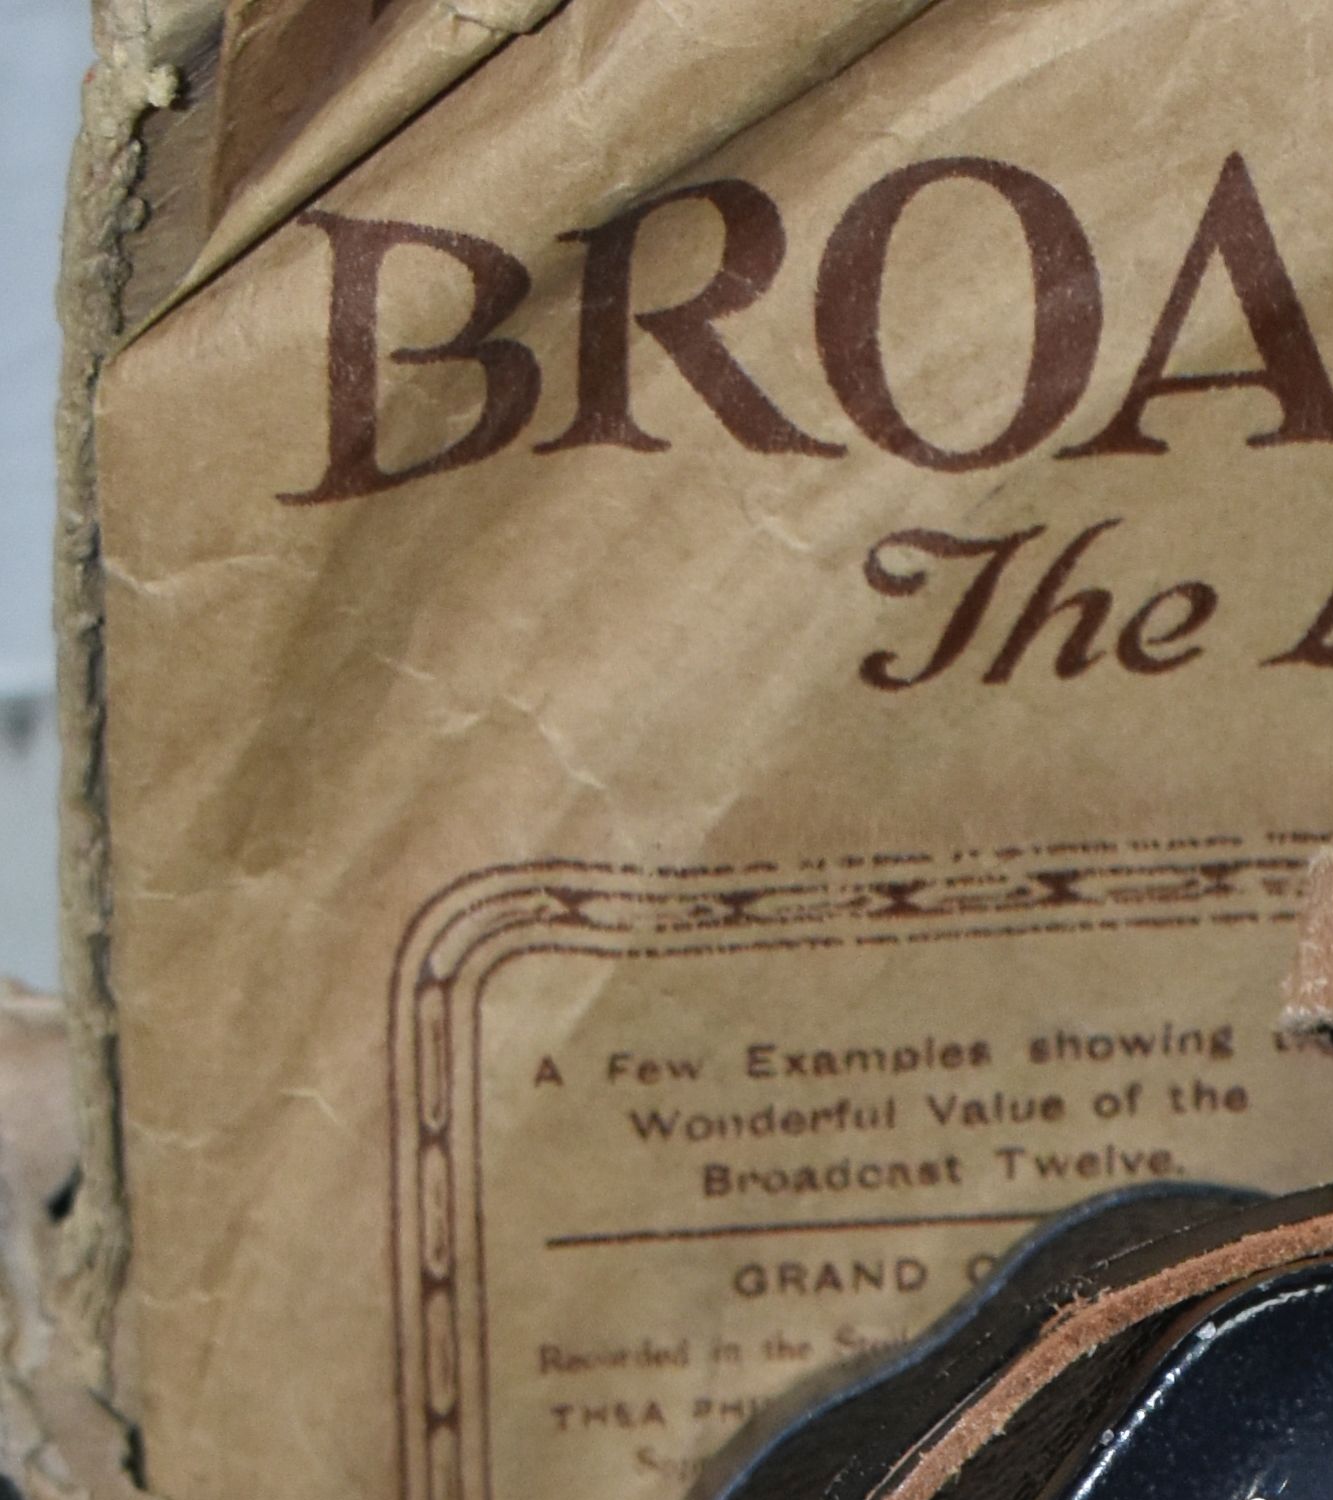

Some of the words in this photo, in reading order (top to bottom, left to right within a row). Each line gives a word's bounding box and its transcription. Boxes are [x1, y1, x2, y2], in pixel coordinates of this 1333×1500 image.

[860, 518, 1220, 694] The
[532, 1054, 565, 1088] A
[606, 1050, 704, 1087] Few
[744, 1035, 993, 1080] Examples
[1028, 1019, 1236, 1066] showing
[629, 1097, 898, 1142] Wonderful
[927, 1088, 1068, 1128] Value
[1092, 1078, 1143, 1121] of
[1166, 1076, 1250, 1115] the
[702, 1153, 964, 1199] Broadcast
[994, 1143, 1187, 1182] Twelve.
[732, 1256, 930, 1301] GRAND
